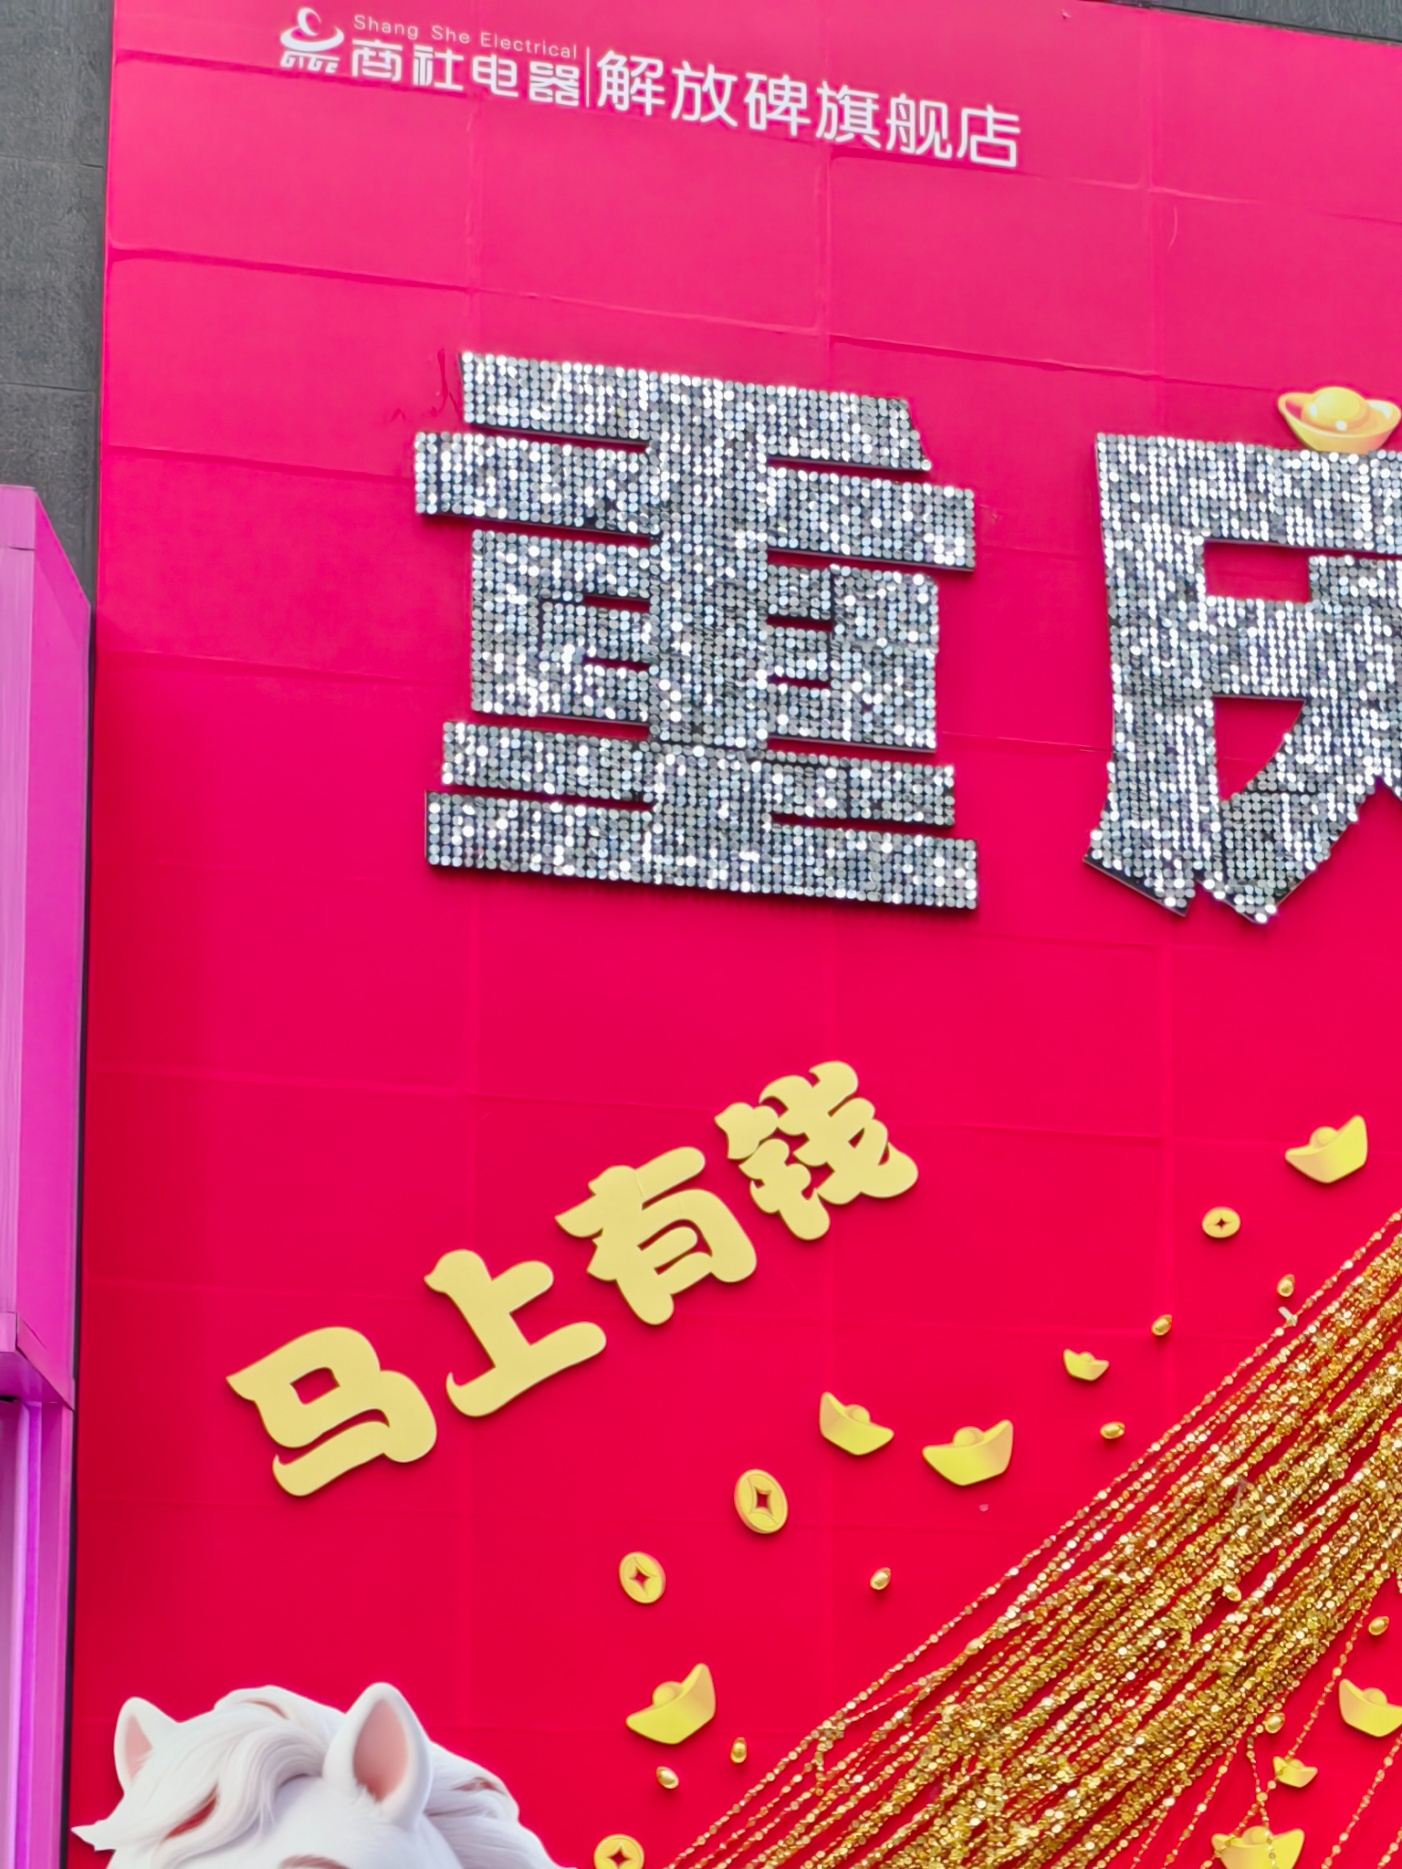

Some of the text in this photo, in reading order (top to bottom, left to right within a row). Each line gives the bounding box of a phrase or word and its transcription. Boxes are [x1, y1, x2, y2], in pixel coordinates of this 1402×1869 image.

[353, 14, 578, 60] Shang She Electrical
[351, 38, 1021, 168] 商社电器 解放碑旗舰店
[226, 1060, 919, 1497] 马上有钱
